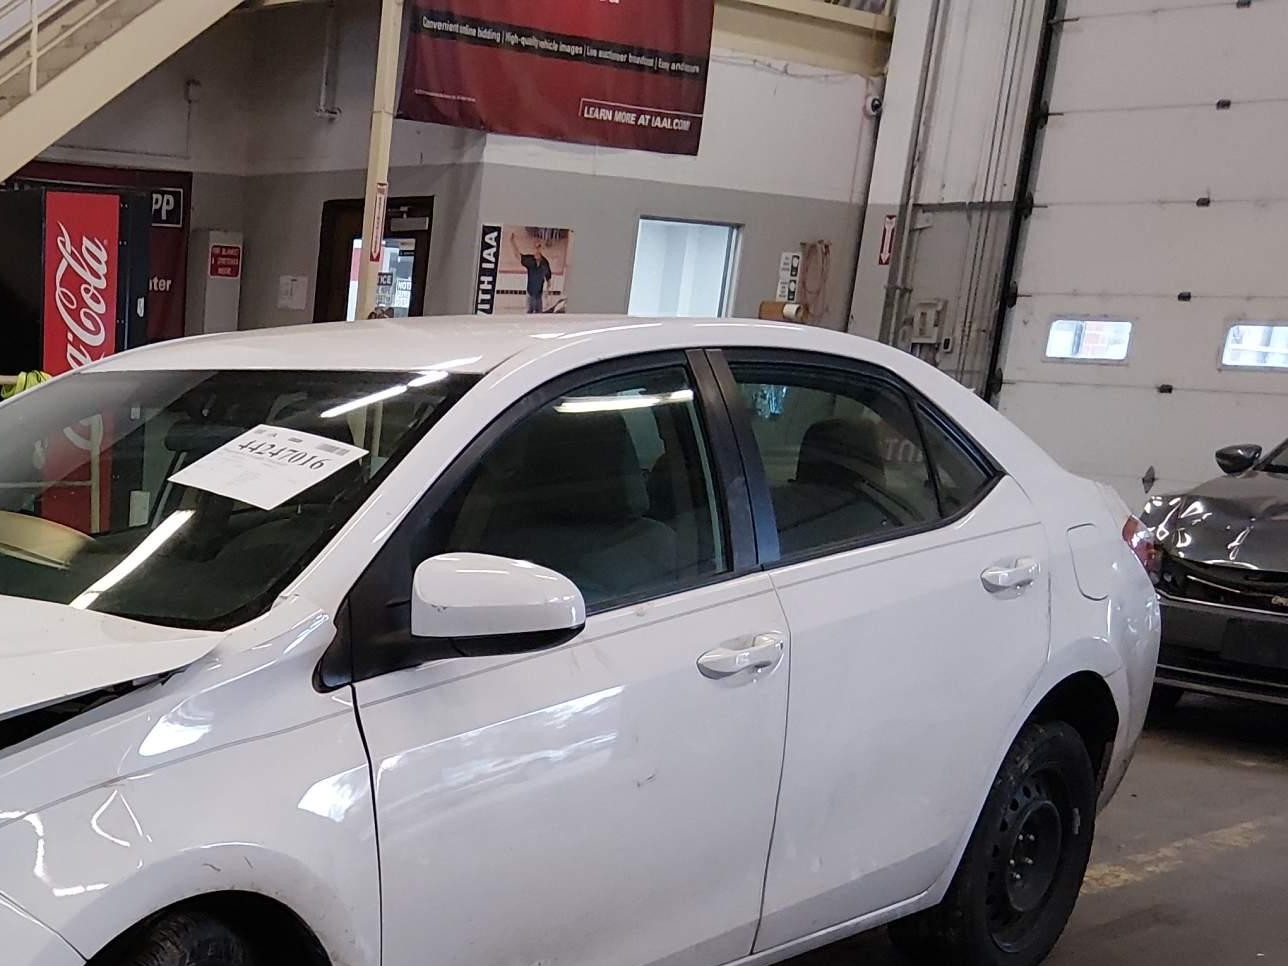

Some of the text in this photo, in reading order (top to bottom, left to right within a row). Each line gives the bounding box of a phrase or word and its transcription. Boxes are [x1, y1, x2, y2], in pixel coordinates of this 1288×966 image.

[422, 16, 459, 33] Convenient
[477, 27, 501, 43] bidding
[559, 41, 583, 55] images
[584, 106, 692, 131] LEARN MORE AT IAAI.COM
[481, 231, 499, 269] IAA
[237, 439, 332, 470] 44247016
